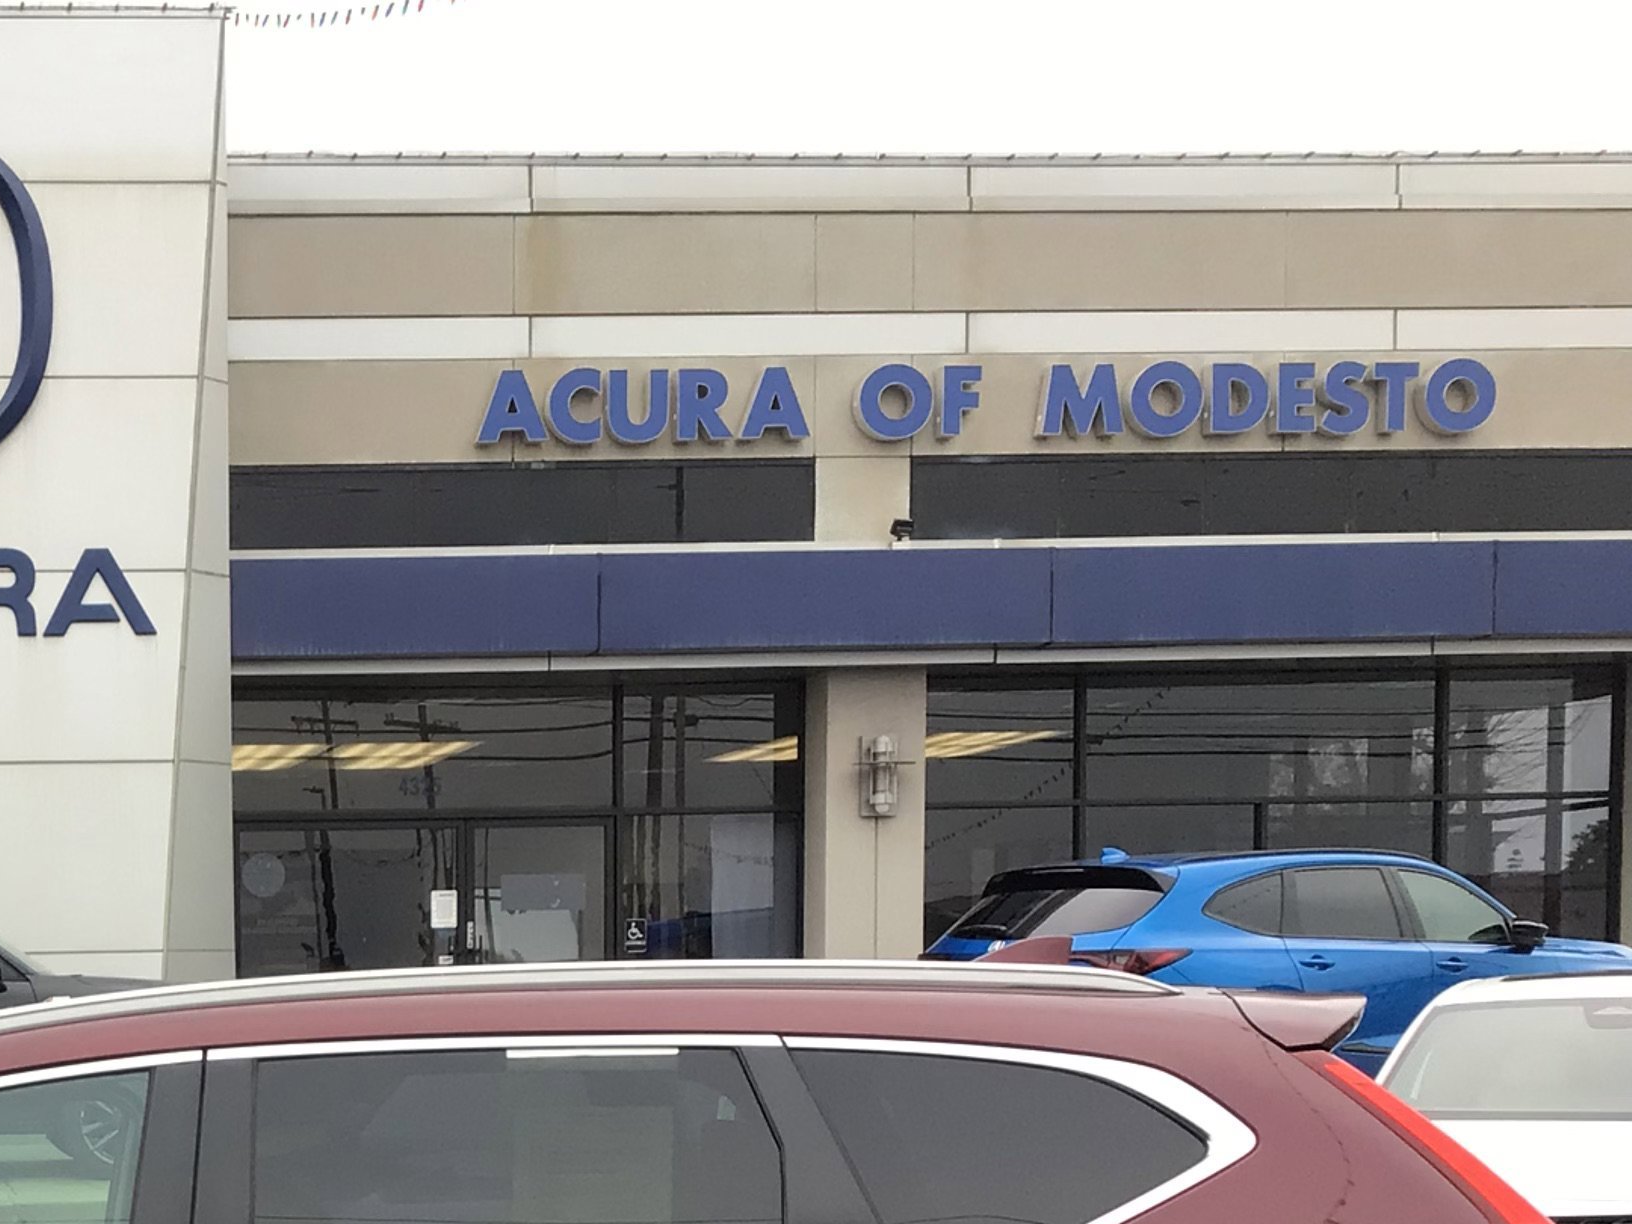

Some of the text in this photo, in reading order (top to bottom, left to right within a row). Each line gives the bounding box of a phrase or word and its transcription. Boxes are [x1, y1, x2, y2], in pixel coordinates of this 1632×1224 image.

[477, 357, 1497, 446] ACURA OF MODESTO
